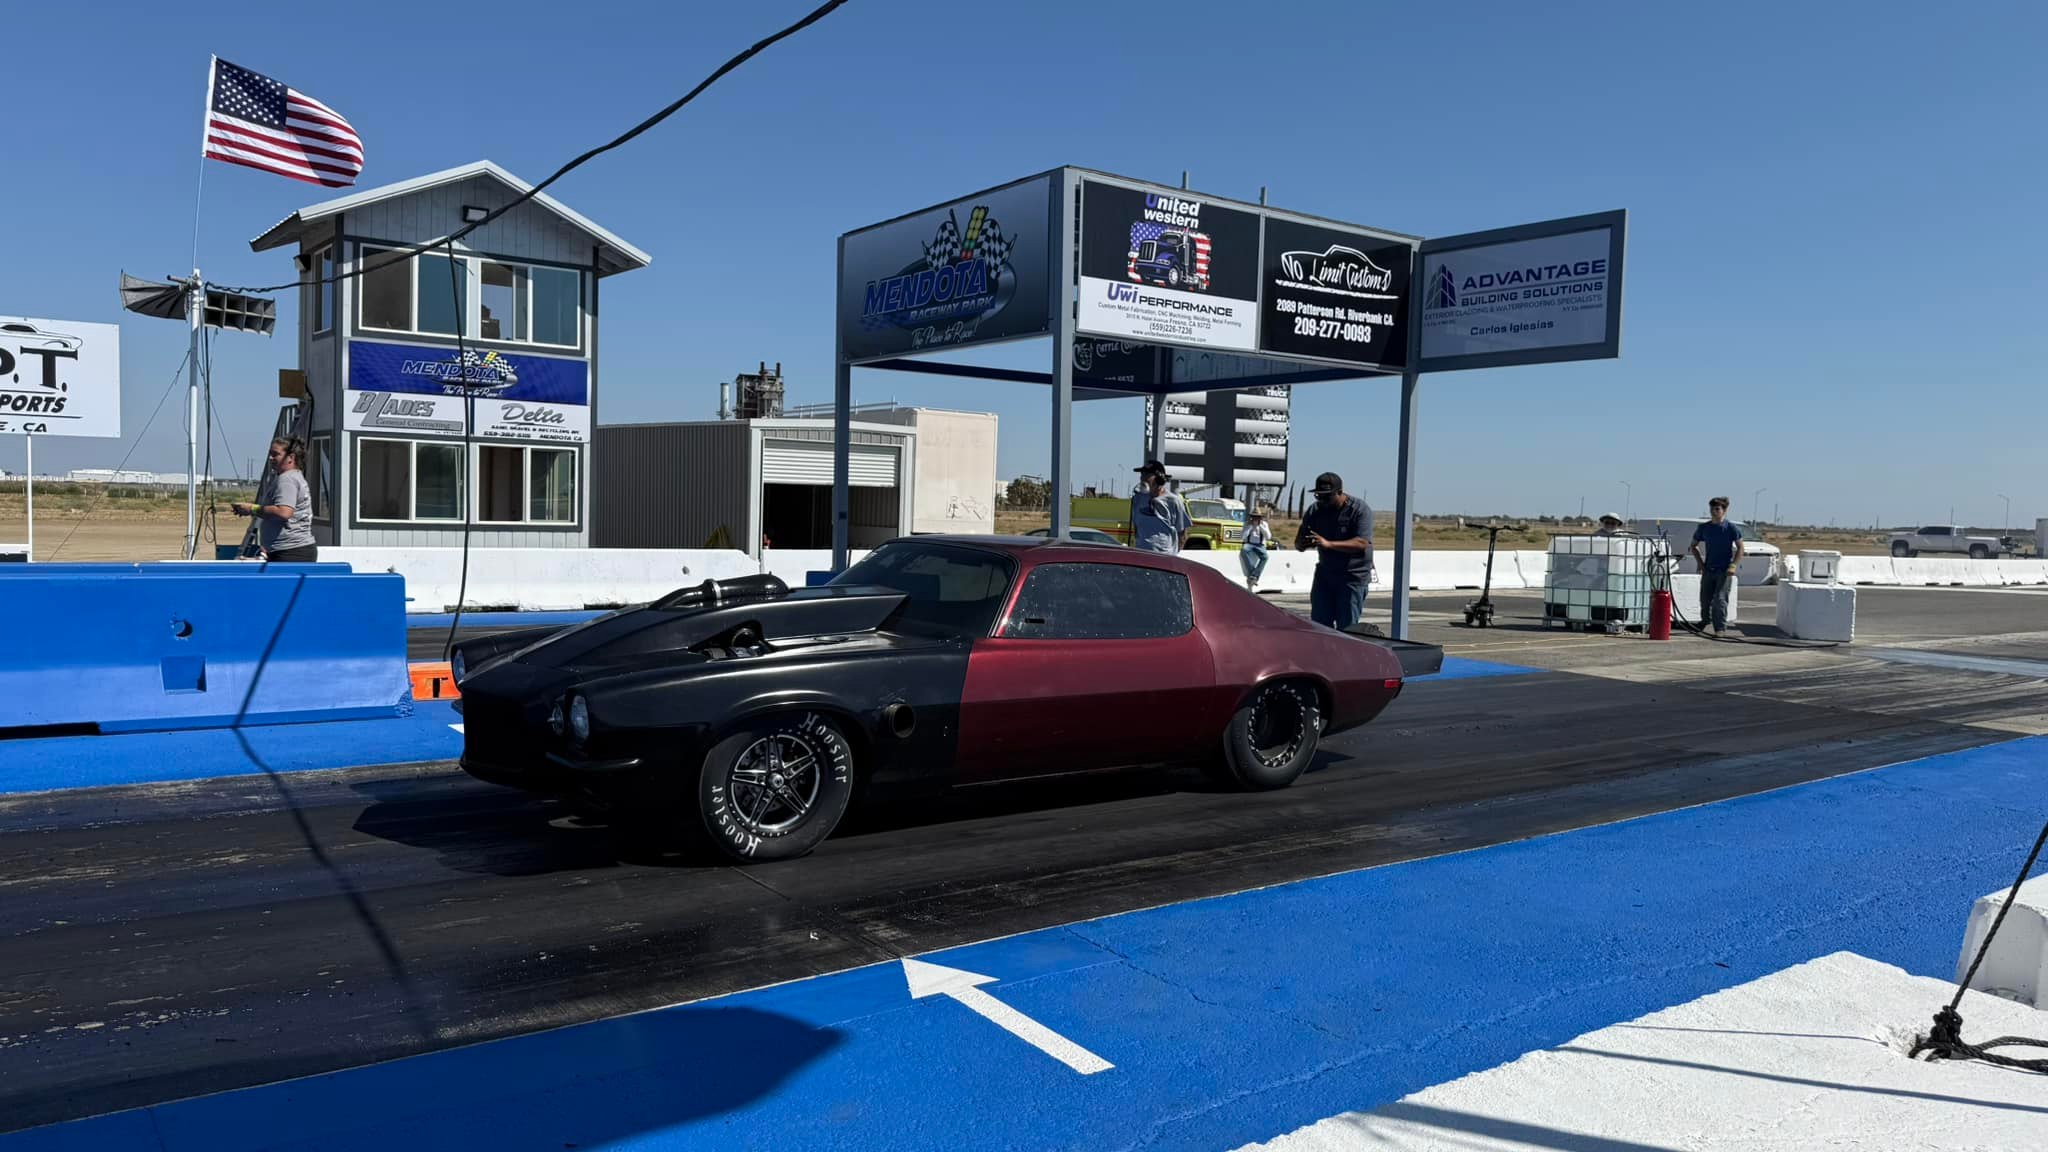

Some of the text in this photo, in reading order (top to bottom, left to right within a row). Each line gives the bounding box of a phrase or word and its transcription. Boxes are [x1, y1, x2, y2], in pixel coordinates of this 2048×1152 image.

[1145, 194, 1200, 217] United
[1144, 208, 1199, 228] western
[1310, 258, 1346, 286] Limit
[1346, 263, 1391, 291] Customs
[1462, 259, 1606, 290] ADVANTAGE
[863, 258, 988, 317] MENDOTA
[1461, 282, 1603, 307] BUILDING SOLUTIONS
[910, 296, 994, 321] RACEWAY PARK
[1139, 296, 1233, 317] PERFORMANCE
[1297, 302, 1334, 318] Patterson
[1335, 307, 1346, 319] Rd.
[1348, 310, 1382, 325] Riverbank
[1294, 316, 1371, 343] 209-277-0093
[1470, 324, 1506, 336] Carlos
[1509, 319, 1554, 334] Iglesias
[401, 359, 499, 380] MENDOTA
[352, 391, 435, 427] BLADES
[501, 402, 565, 424] Delta
[23, 422, 47, 432] CA
